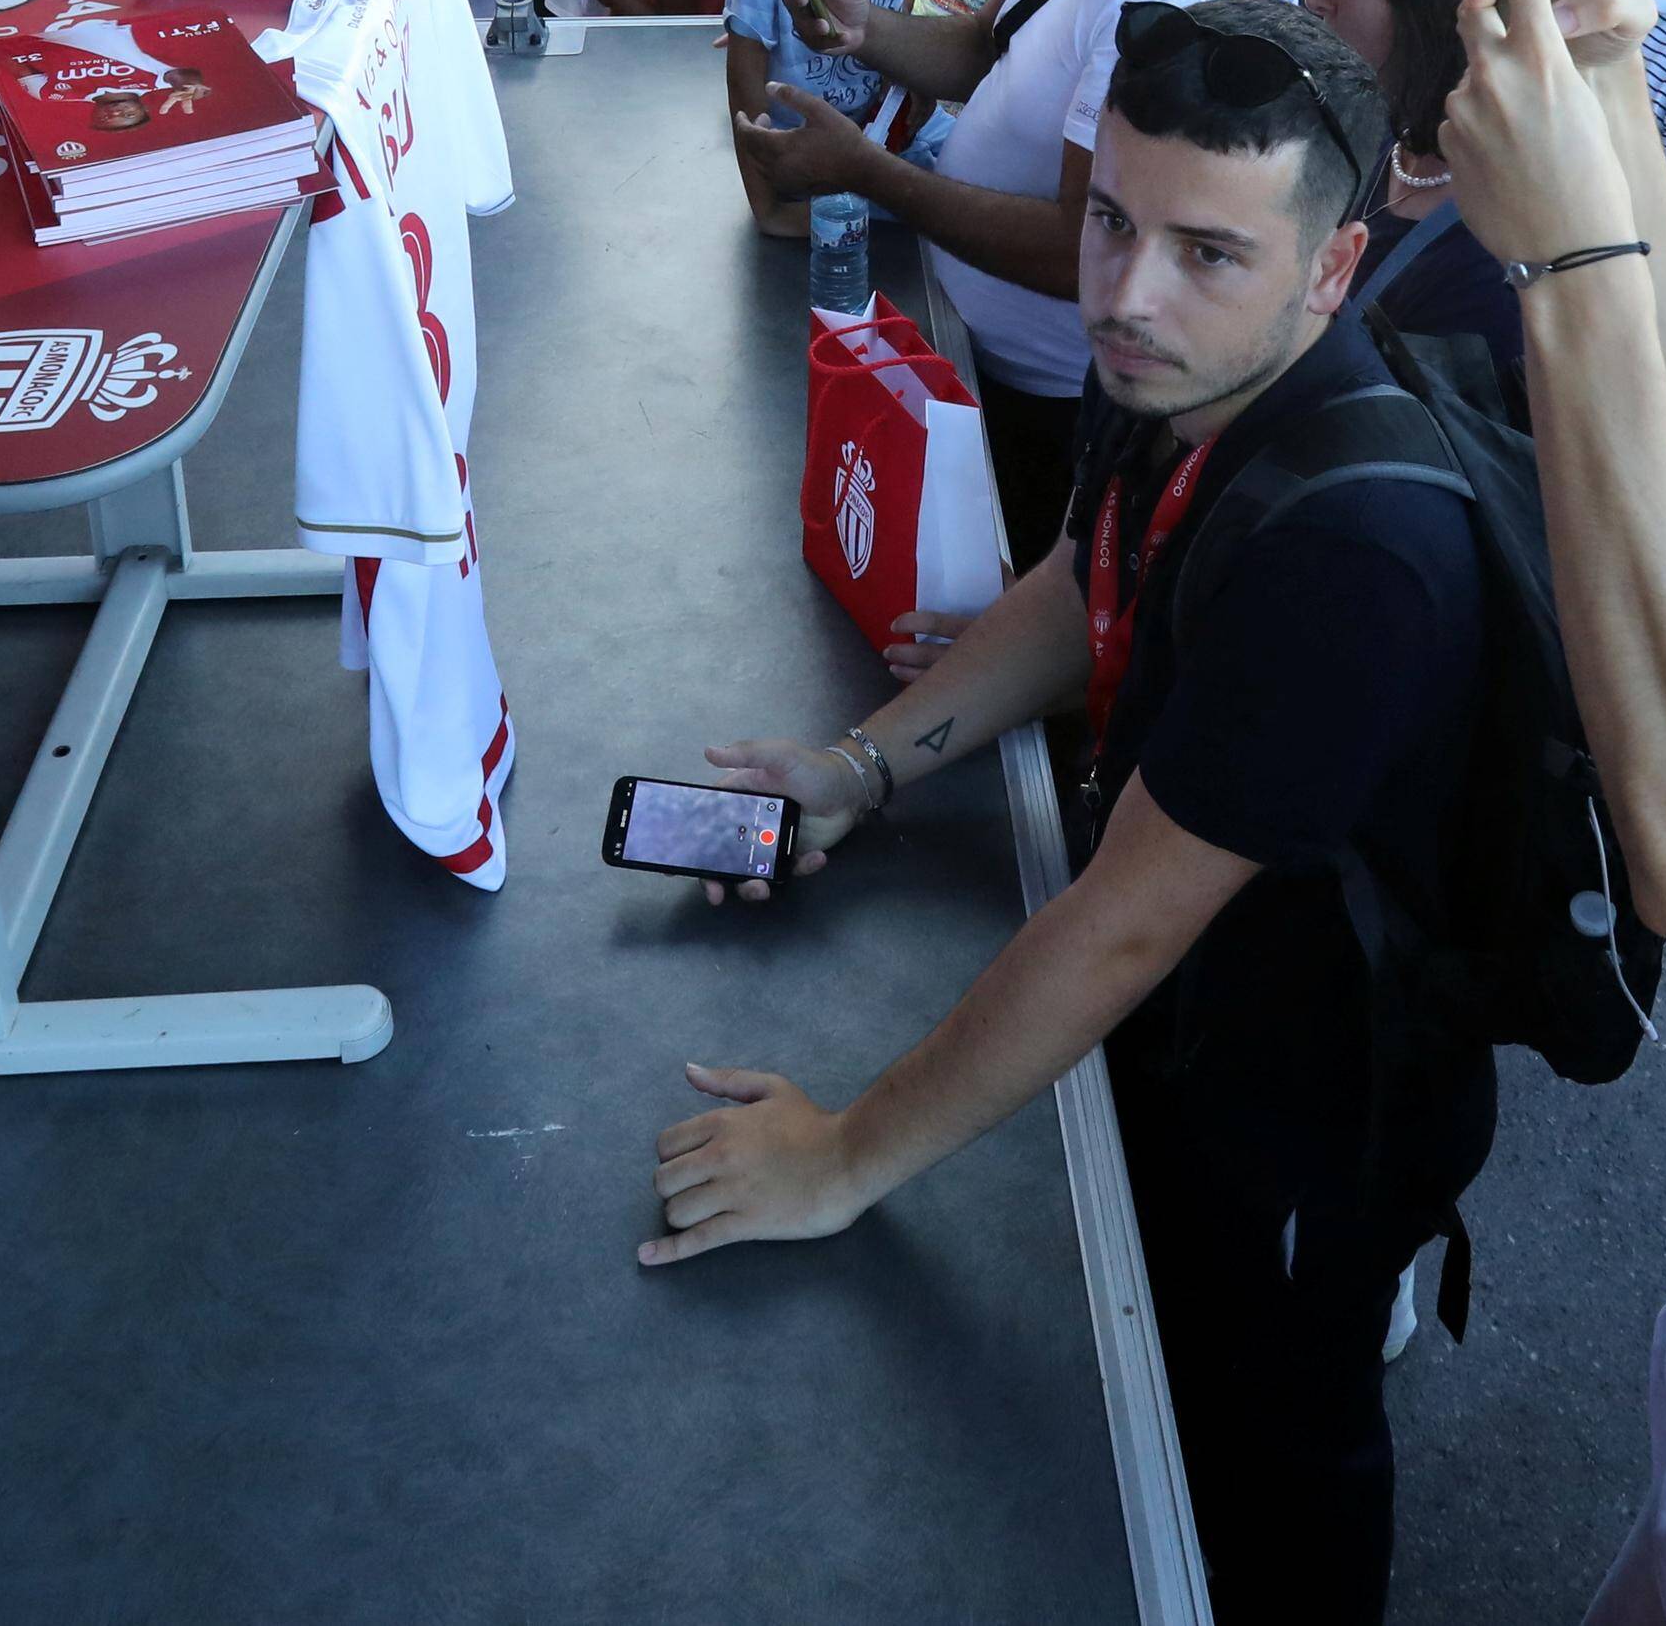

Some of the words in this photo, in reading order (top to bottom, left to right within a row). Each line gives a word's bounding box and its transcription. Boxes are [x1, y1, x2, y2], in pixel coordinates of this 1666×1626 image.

[12, 51, 44, 64] 31
[56, 61, 136, 82] apm
[823, 85, 857, 106] Big
[1099, 509, 1116, 568] MONACO
